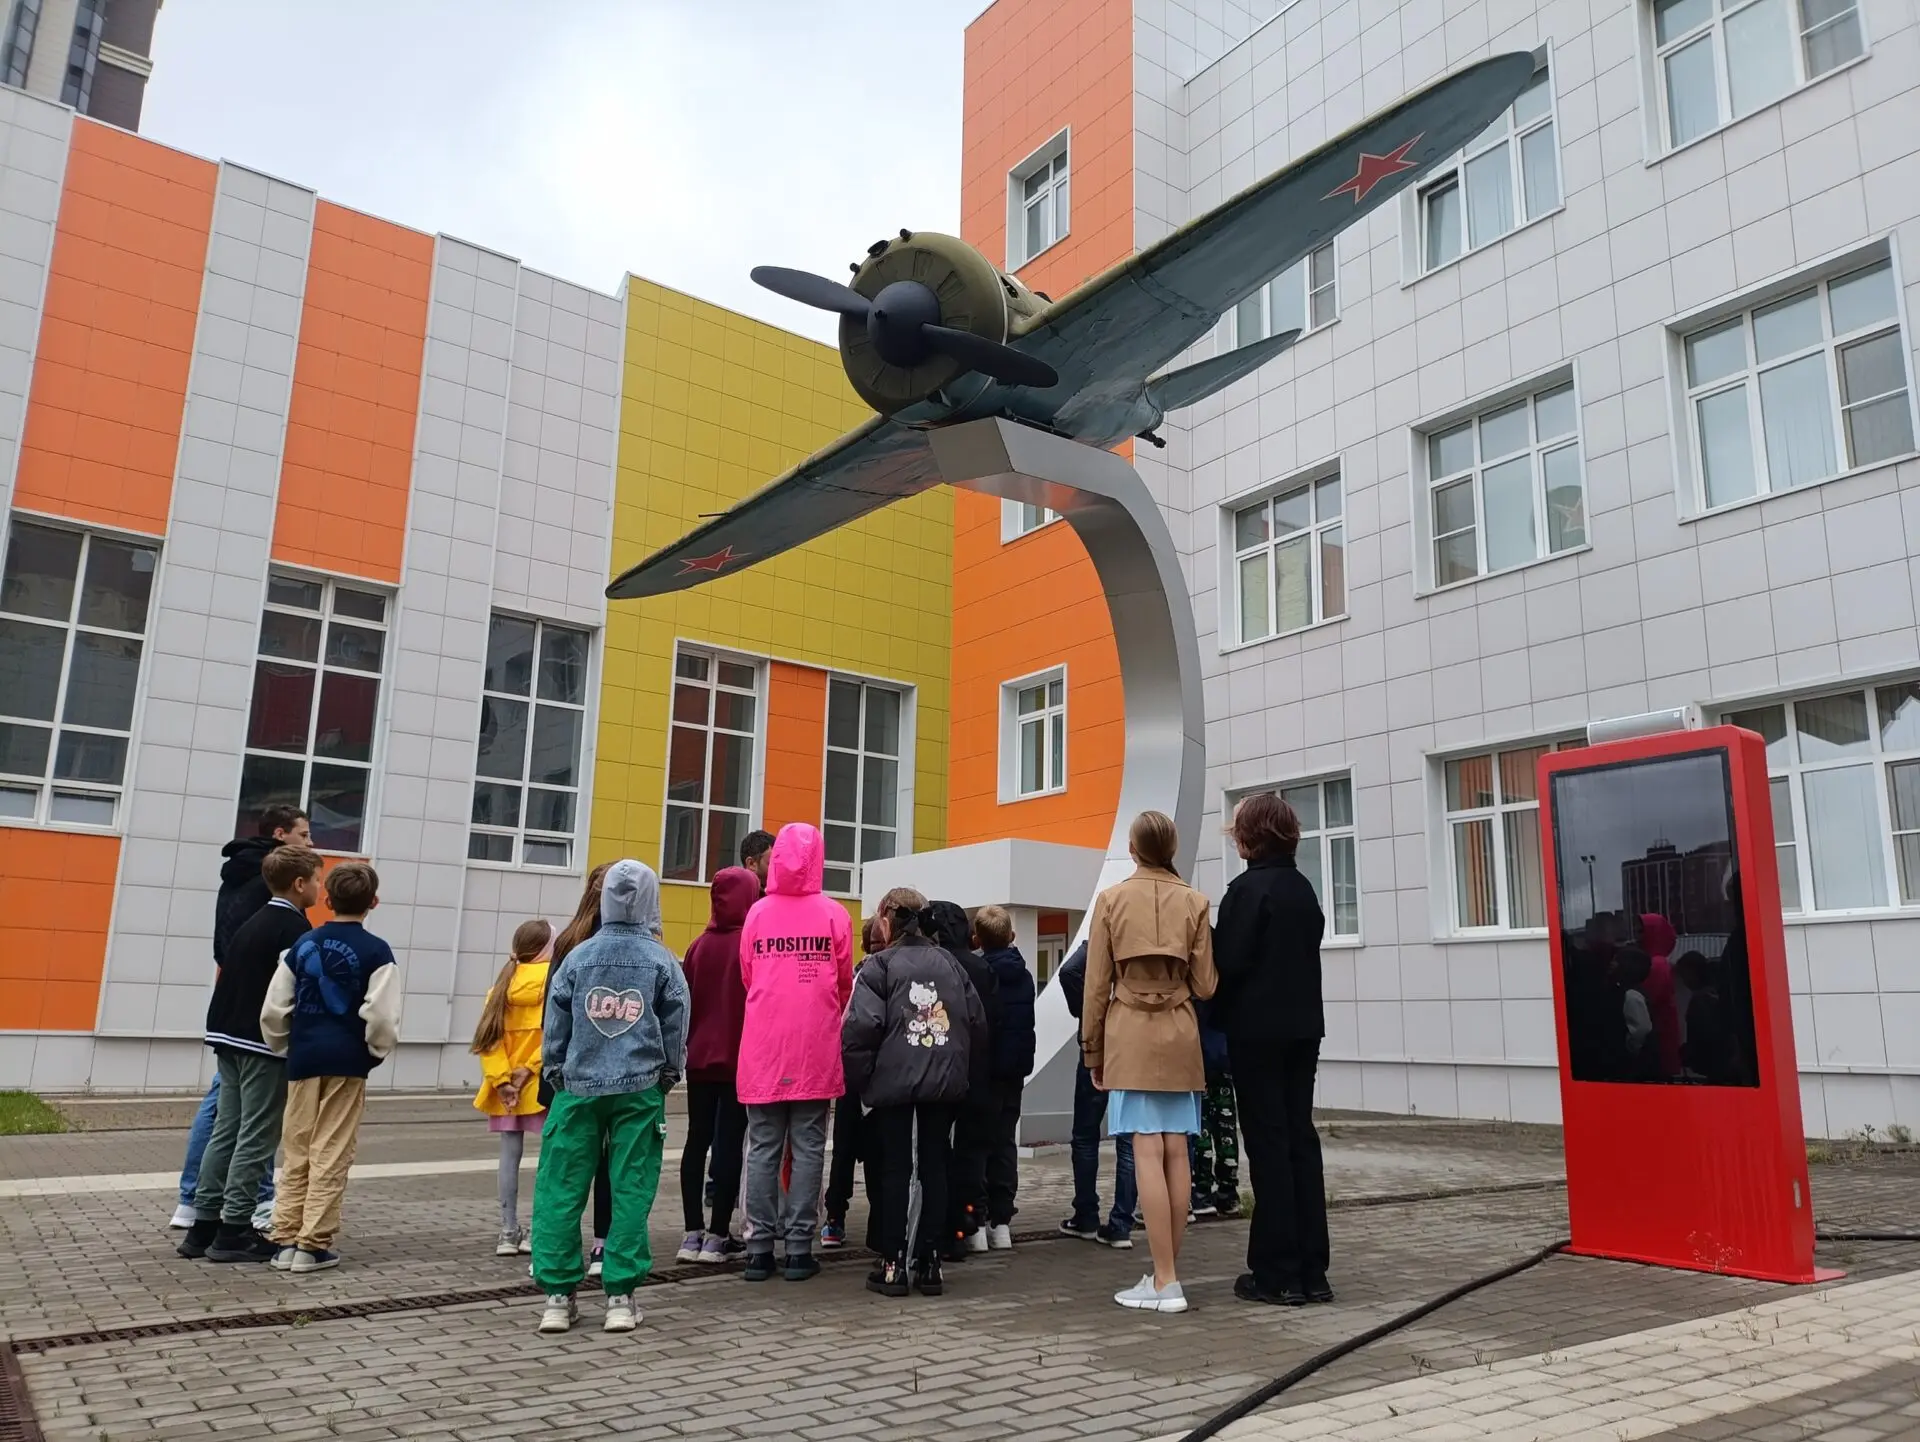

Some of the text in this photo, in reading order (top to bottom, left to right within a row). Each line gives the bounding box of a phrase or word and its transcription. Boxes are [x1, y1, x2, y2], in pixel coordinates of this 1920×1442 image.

[766, 937, 832, 953] POSITIVE
[808, 953, 830, 961] better
[590, 994, 641, 1023] LOVE
